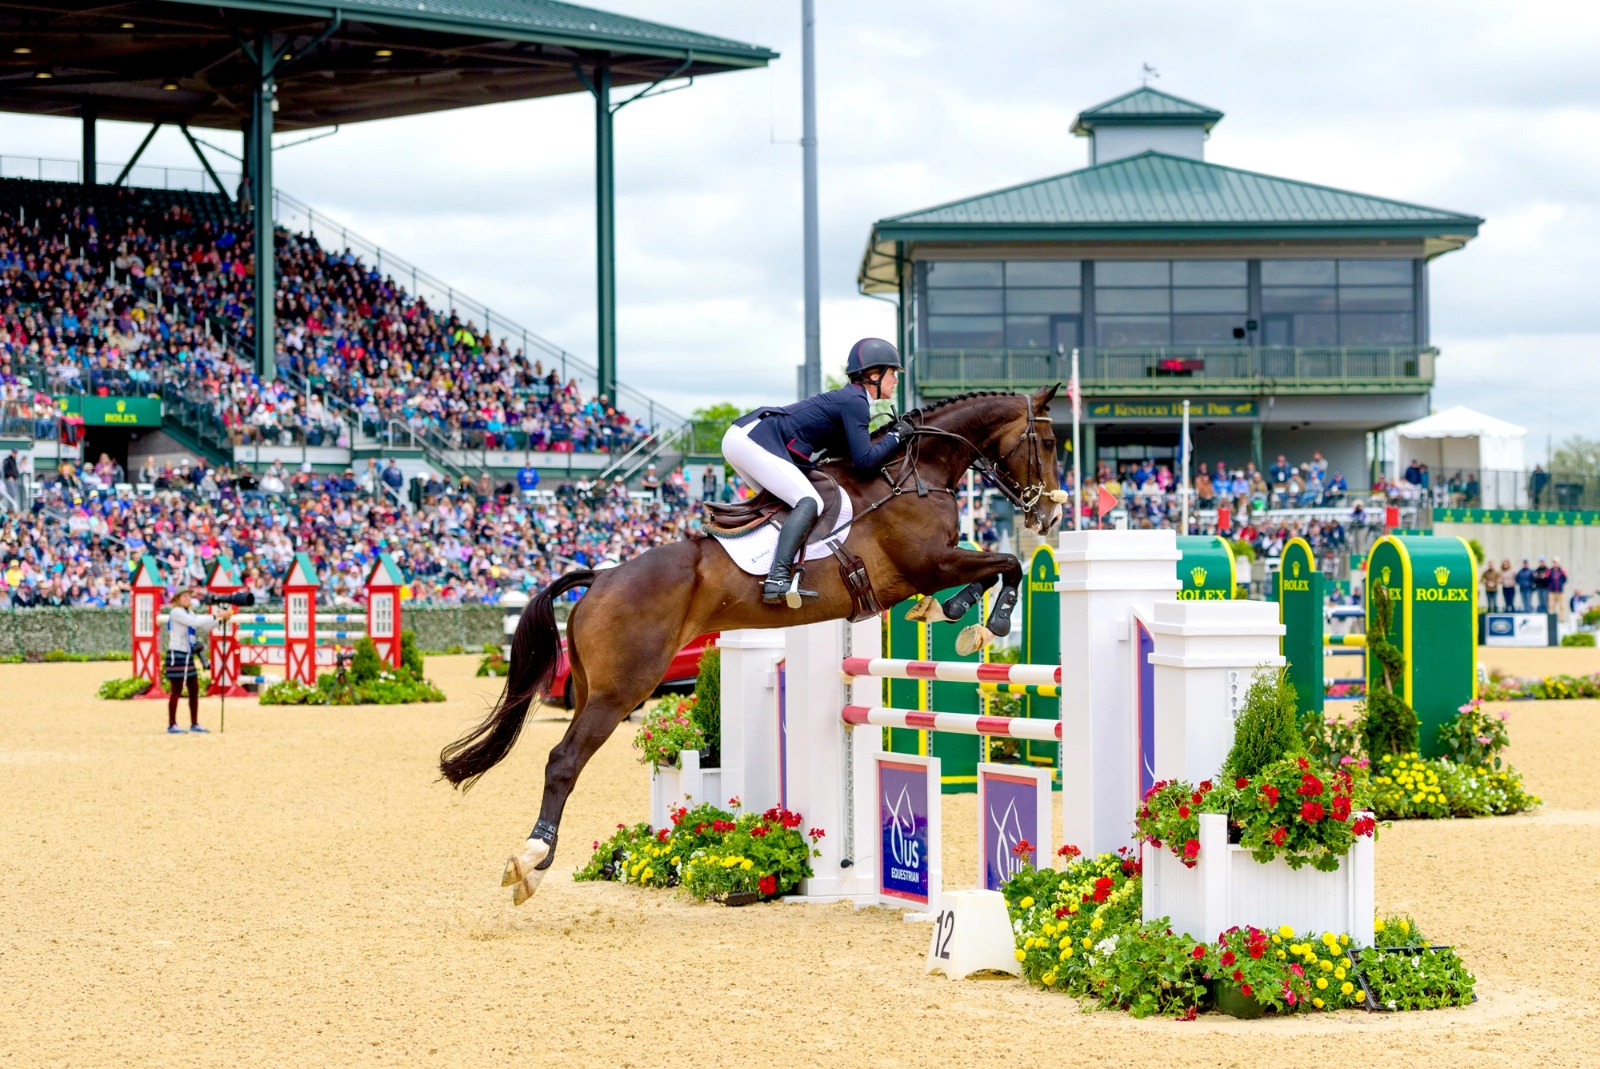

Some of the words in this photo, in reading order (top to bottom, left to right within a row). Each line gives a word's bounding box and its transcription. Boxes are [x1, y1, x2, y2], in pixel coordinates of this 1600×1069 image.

[1031, 582, 1054, 592] ROLEX
[1283, 580, 1309, 591] ROLEX
[1416, 588, 1469, 601] ROLEX
[891, 867, 920, 883] EQUESTRIAN
[935, 910, 955, 960] 12
